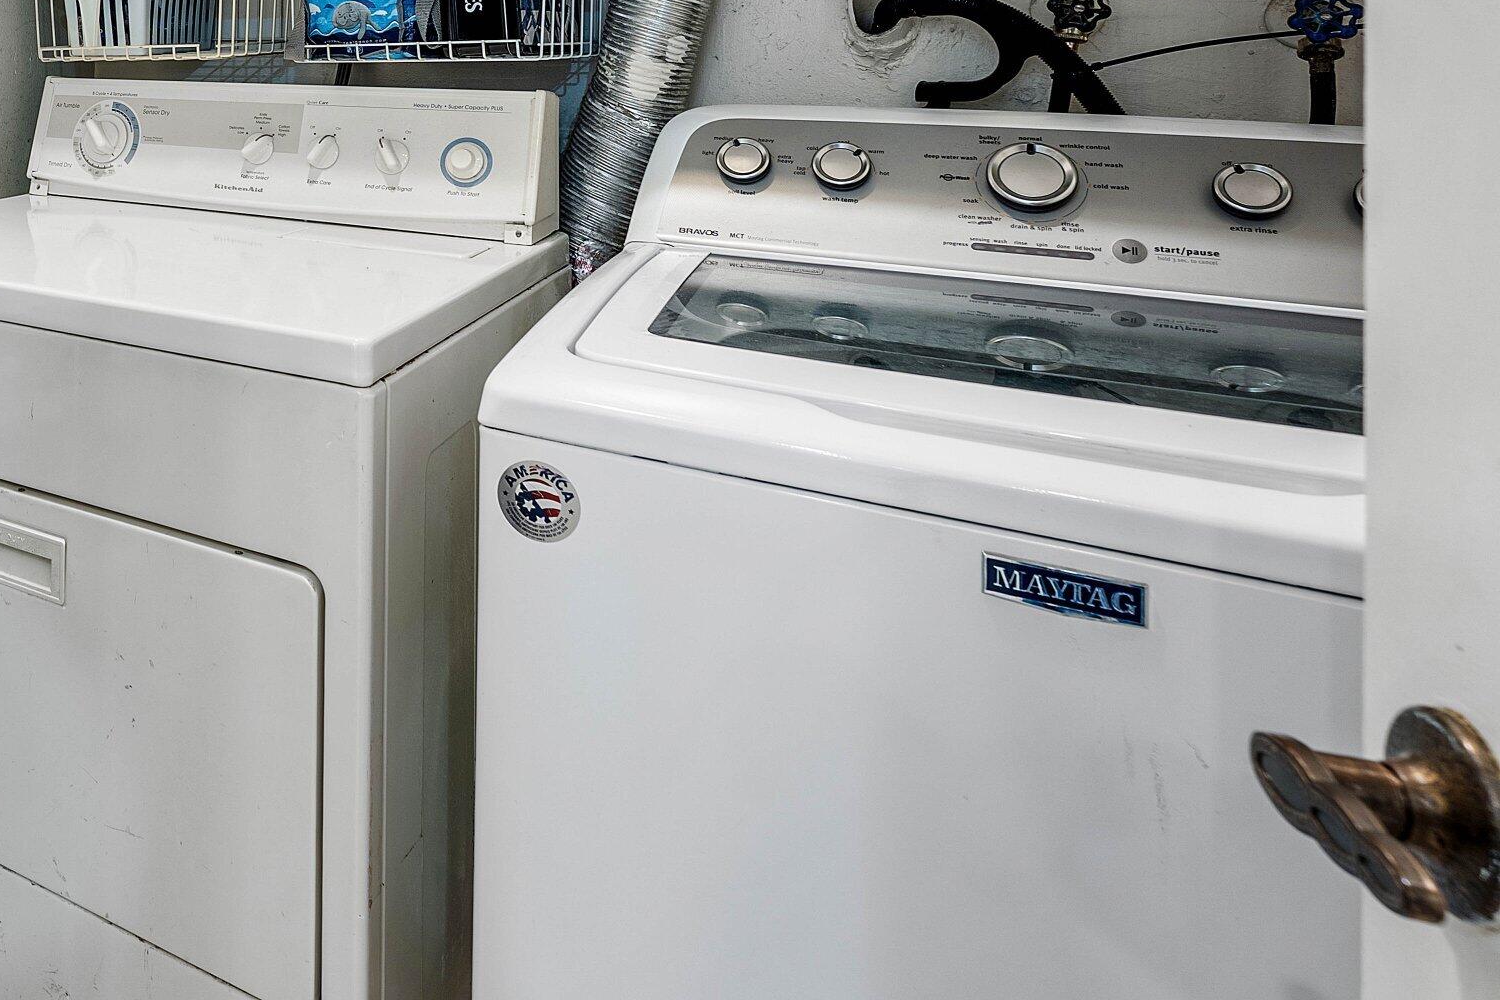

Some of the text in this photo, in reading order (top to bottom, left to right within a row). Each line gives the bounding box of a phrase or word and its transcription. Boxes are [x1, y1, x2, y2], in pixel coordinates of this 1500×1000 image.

[214, 183, 263, 193] KitchenAid
[678, 227, 719, 237] BRAVOS
[1154, 246, 1220, 258] start/pause
[505, 464, 574, 503] AMERICA
[993, 565, 1137, 615] MAYTAG
